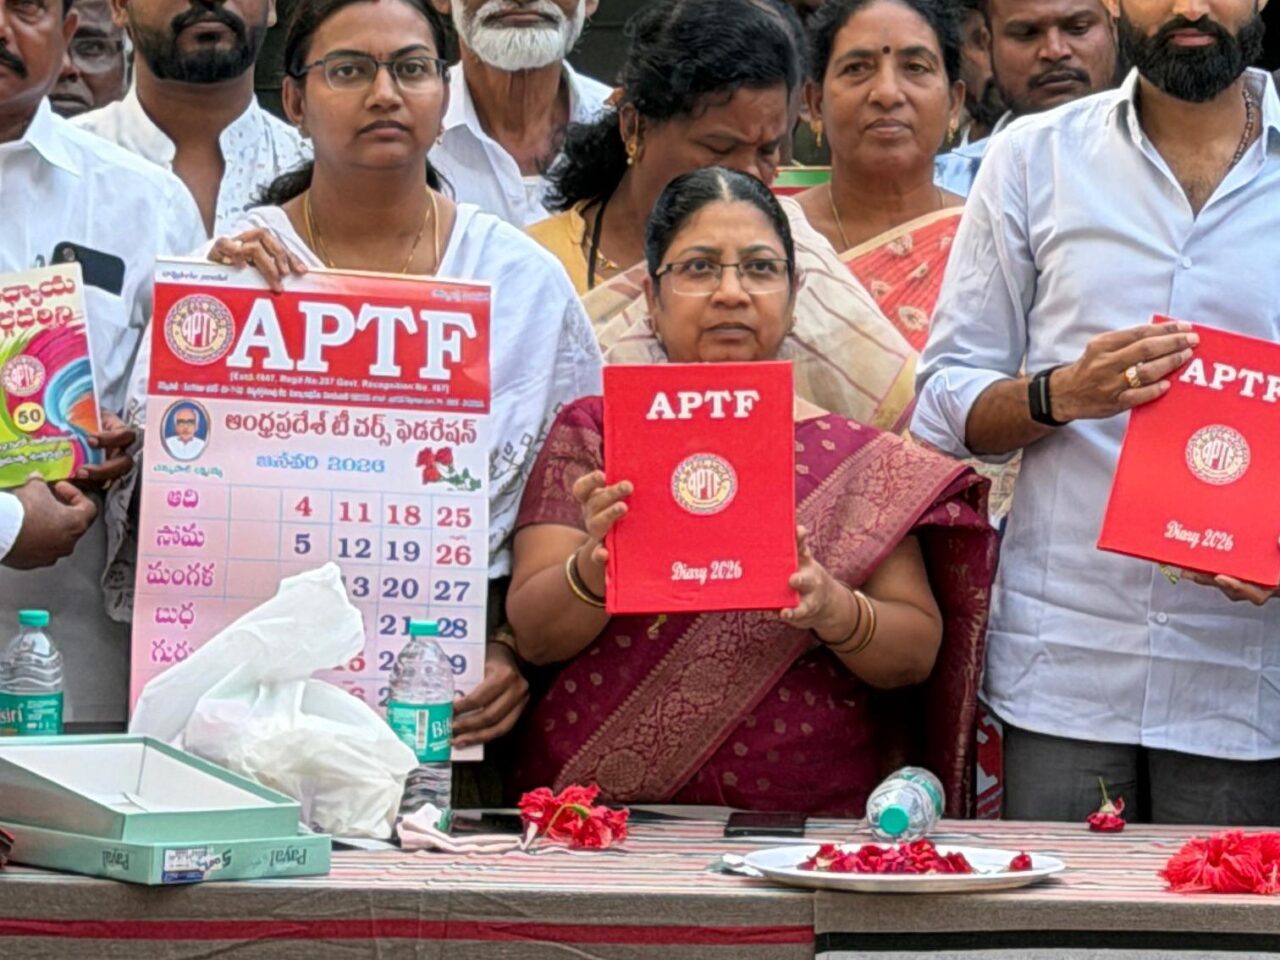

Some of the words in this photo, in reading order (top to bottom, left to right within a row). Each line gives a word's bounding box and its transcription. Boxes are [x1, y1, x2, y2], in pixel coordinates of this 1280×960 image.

[225, 297, 478, 381] APTF
[645, 390, 760, 421] APTF
[224, 411, 328, 439] ఆంధ్రప్రదేశ్
[167, 489, 200, 509] ఆది
[295, 496, 312, 517] 4
[339, 502, 371, 523] 11
[387, 505, 422, 527] 18
[436, 506, 472, 529] 25
[156, 522, 205, 548] సోమ
[294, 533, 311, 555] 5
[337, 537, 372, 559] 12
[386, 540, 420, 562] 19
[435, 543, 472, 566] 26
[1163, 520, 1201, 549] Diary
[1201, 528, 1234, 552] 2026
[146, 561, 215, 588] మంగళ
[341, 577, 370, 598] 3
[382, 577, 419, 600] 20
[434, 580, 471, 602] 27
[671, 561, 707, 585] Diary
[710, 560, 743, 580] 2026
[155, 602, 196, 630] బుధ
[379, 614, 412, 636] 21
[436, 617, 468, 639] 28
[269, 847, 307, 867] Payal
